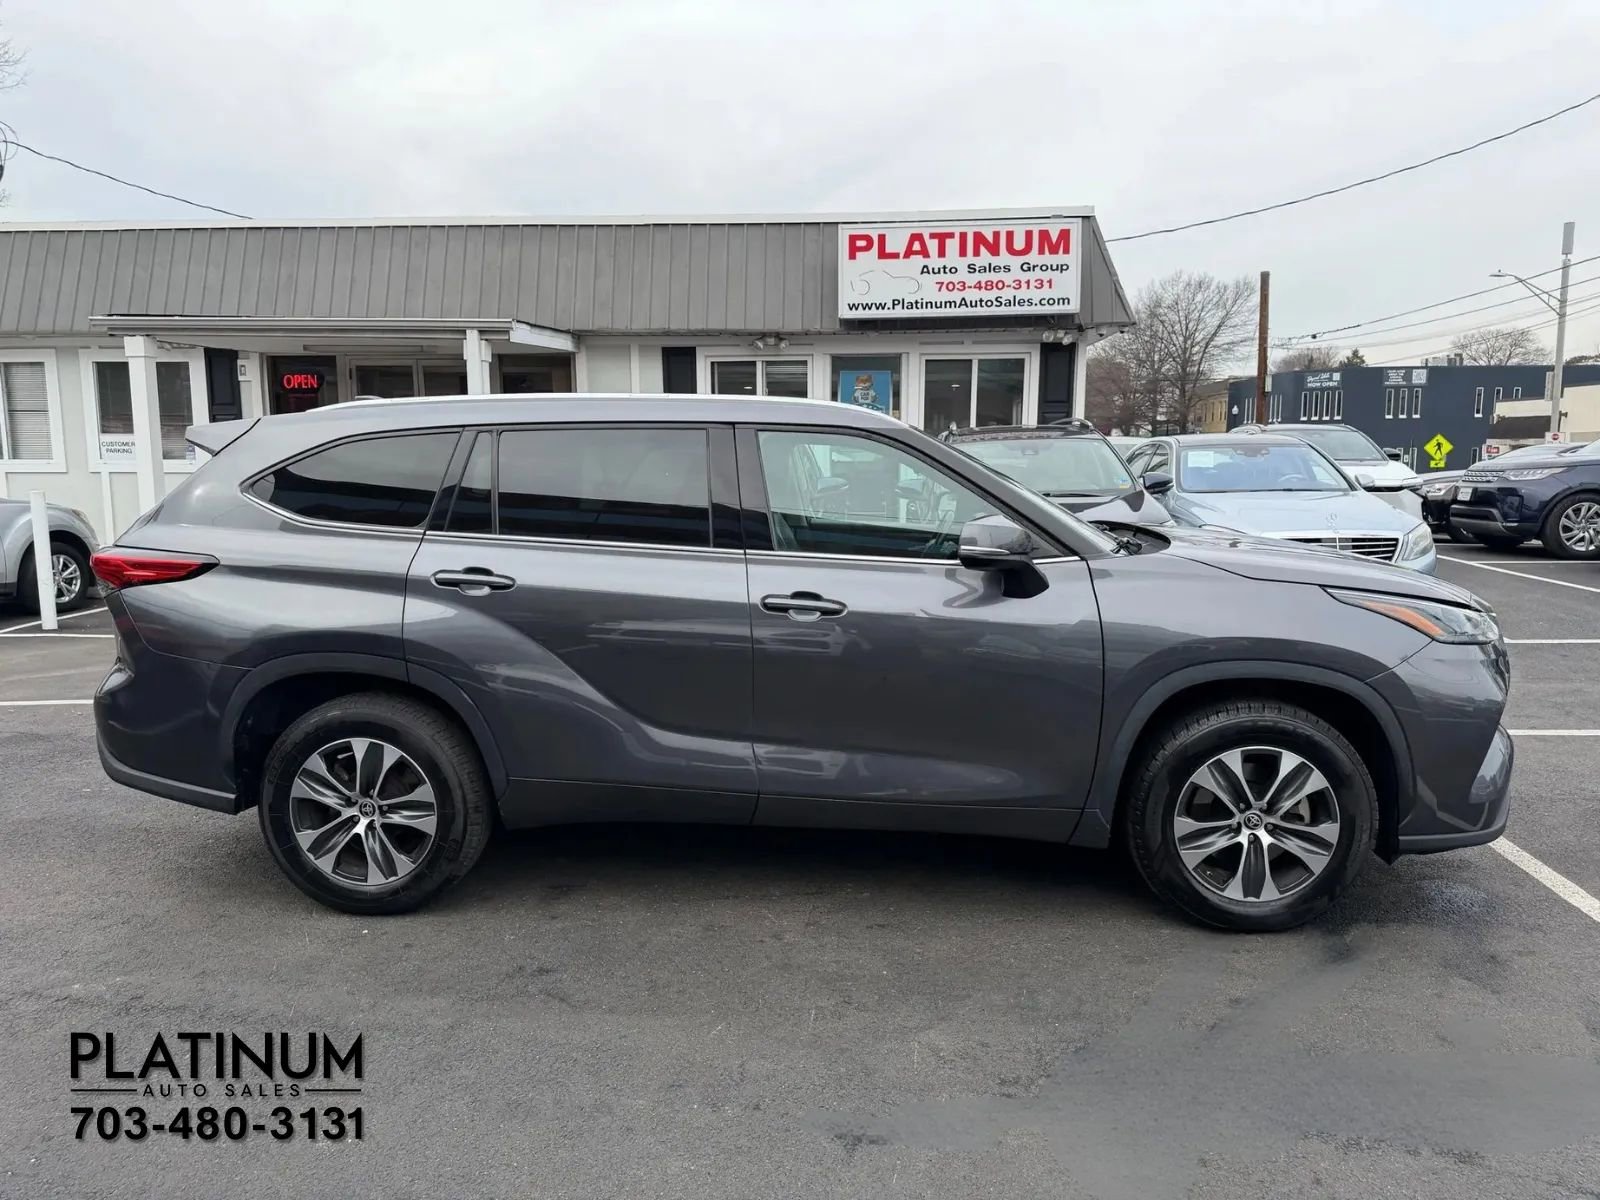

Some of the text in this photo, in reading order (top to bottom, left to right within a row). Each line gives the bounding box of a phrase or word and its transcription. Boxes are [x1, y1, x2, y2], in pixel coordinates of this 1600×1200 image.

[848, 228, 1071, 260] PLATINUM
[920, 262, 1070, 275] Auto Sales Group
[935, 278, 1053, 292] 703-480-3131
[847, 296, 1070, 312] www.PlatinumAutoSales.com
[283, 374, 318, 389] OPEN
